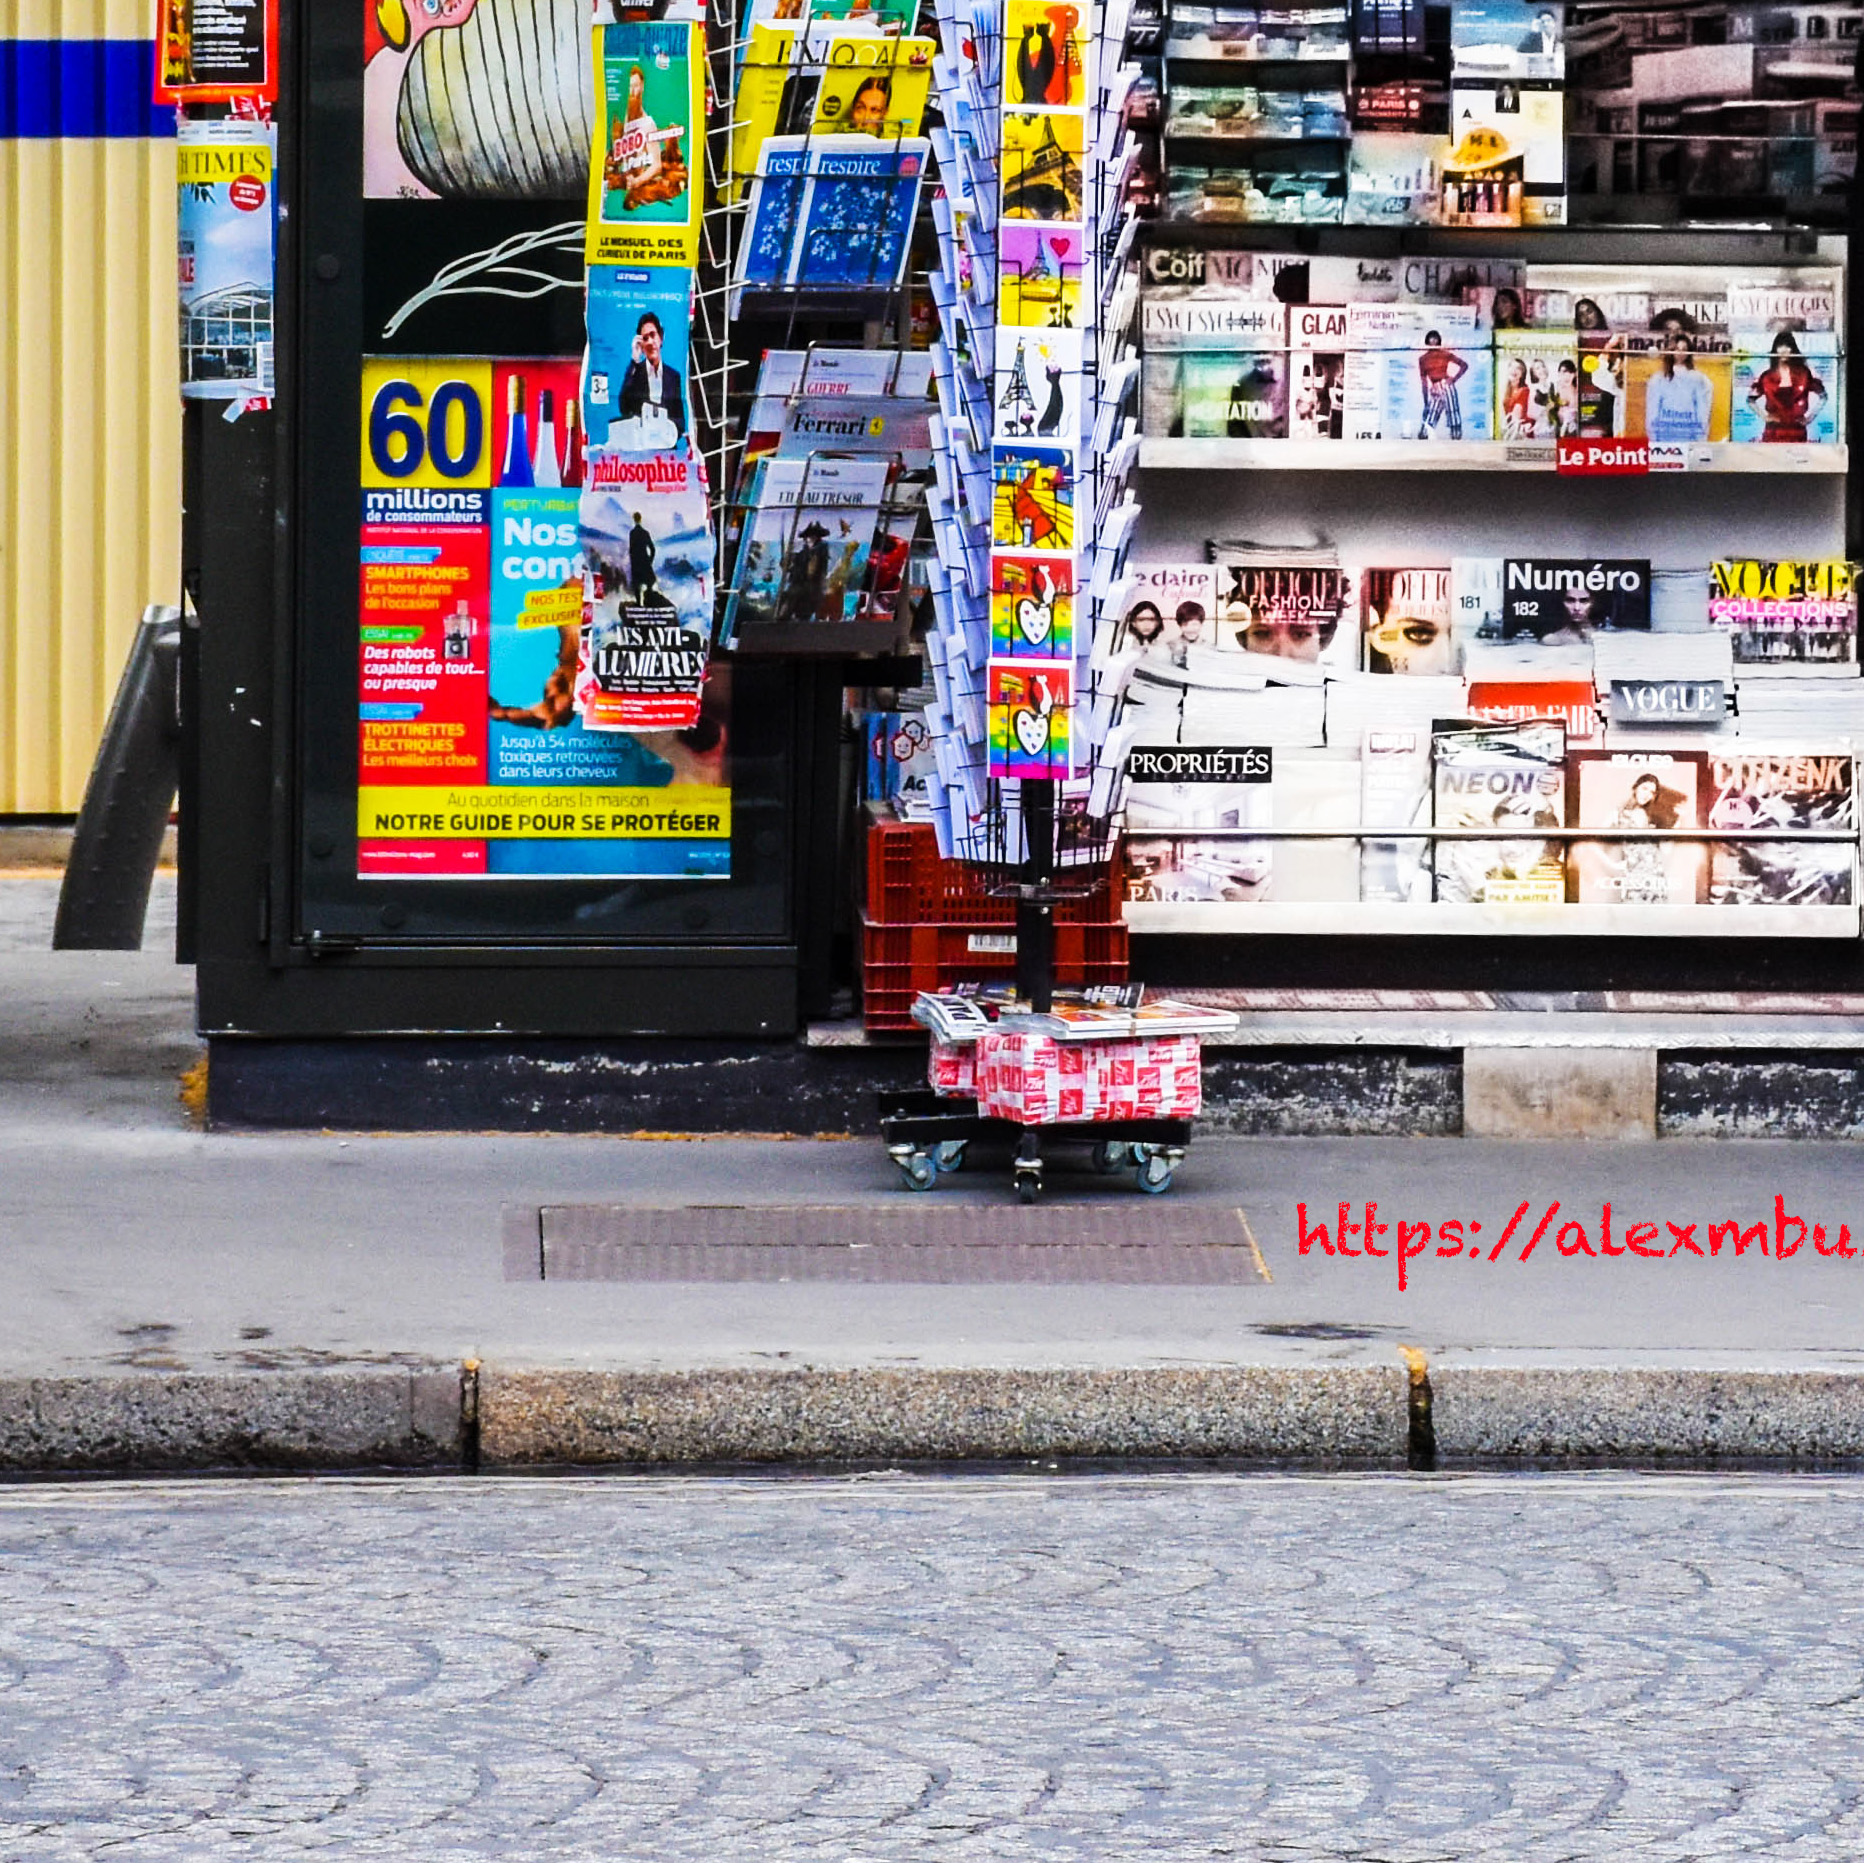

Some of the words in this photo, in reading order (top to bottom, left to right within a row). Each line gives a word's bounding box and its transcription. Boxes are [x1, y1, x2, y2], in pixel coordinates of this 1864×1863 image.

[613, 131, 643, 160] BOBO
[191, 150, 266, 174] TIMES
[820, 155, 881, 175] respire
[600, 237, 611, 248] LE
[613, 237, 653, 248] MENSUEL
[657, 238, 683, 249] DES
[597, 248, 630, 260] CURIEUX
[631, 249, 646, 260] DE
[649, 250, 686, 261] PARIS
[369, 379, 483, 478] 60
[793, 413, 866, 436] Ferrari
[1559, 447, 1583, 467] Le
[1588, 445, 1647, 467] Point
[592, 454, 687, 491] philosophie
[366, 489, 482, 509] millions
[366, 510, 381, 523] de
[385, 510, 482, 523] consommateurs
[503, 517, 576, 546] Nos
[366, 566, 469, 580] SMARTPHONES
[1150, 569, 1209, 588] claire
[1508, 562, 1640, 592] Numéro
[1713, 561, 1850, 599] VOGUE
[366, 583, 386, 594] Les
[388, 583, 417, 594] bons
[419, 583, 452, 596] plans
[365, 597, 380, 609] de
[382, 596, 440, 609] l'occasion
[531, 594, 554, 606] NOS
[1249, 594, 1325, 611] FASHION
[1459, 595, 1481, 609] 181
[1512, 602, 1539, 617] 182
[1714, 601, 1849, 618] COLLECTIONS
[617, 626, 643, 646] LES
[364, 646, 389, 659] Des
[391, 646, 435, 659] robots
[599, 643, 706, 677] LUMIÈRES
[364, 661, 423, 676] capables
[425, 661, 442, 674] de
[364, 679, 381, 689] ou
[383, 679, 437, 691] presque
[1621, 686, 1715, 711] VOGUE
[364, 723, 465, 736] TROTTINETTES
[363, 736, 455, 753] ÉLECTRIQUES
[500, 736, 545, 750] Jusqu'à
[549, 736, 566, 748] 54
[569, 735, 632, 749] molécules
[363, 754, 385, 766] Les
[387, 754, 442, 766] meilleurs
[445, 754, 478, 766] choix
[500, 751, 553, 765] toxiques
[557, 750, 622, 764] retrouvées
[1131, 748, 1269, 775] PROPRIÉTÉS
[500, 766, 531, 778] dans
[533, 766, 563, 778] leurs
[566, 766, 618, 779] cheveux
[1443, 773, 1534, 795] NEON
[447, 792, 467, 807] Au
[470, 792, 538, 811] quotidien
[541, 792, 576, 807] dans
[580, 792, 592, 807] la
[596, 793, 649, 807] maison
[375, 815, 444, 831] NOTRE
[450, 815, 512, 831] GUIDE
[520, 815, 576, 831] POUR
[582, 815, 606, 831] SE
[612, 810, 720, 831] PROTÉGER
[1130, 886, 1199, 902] PARIS
